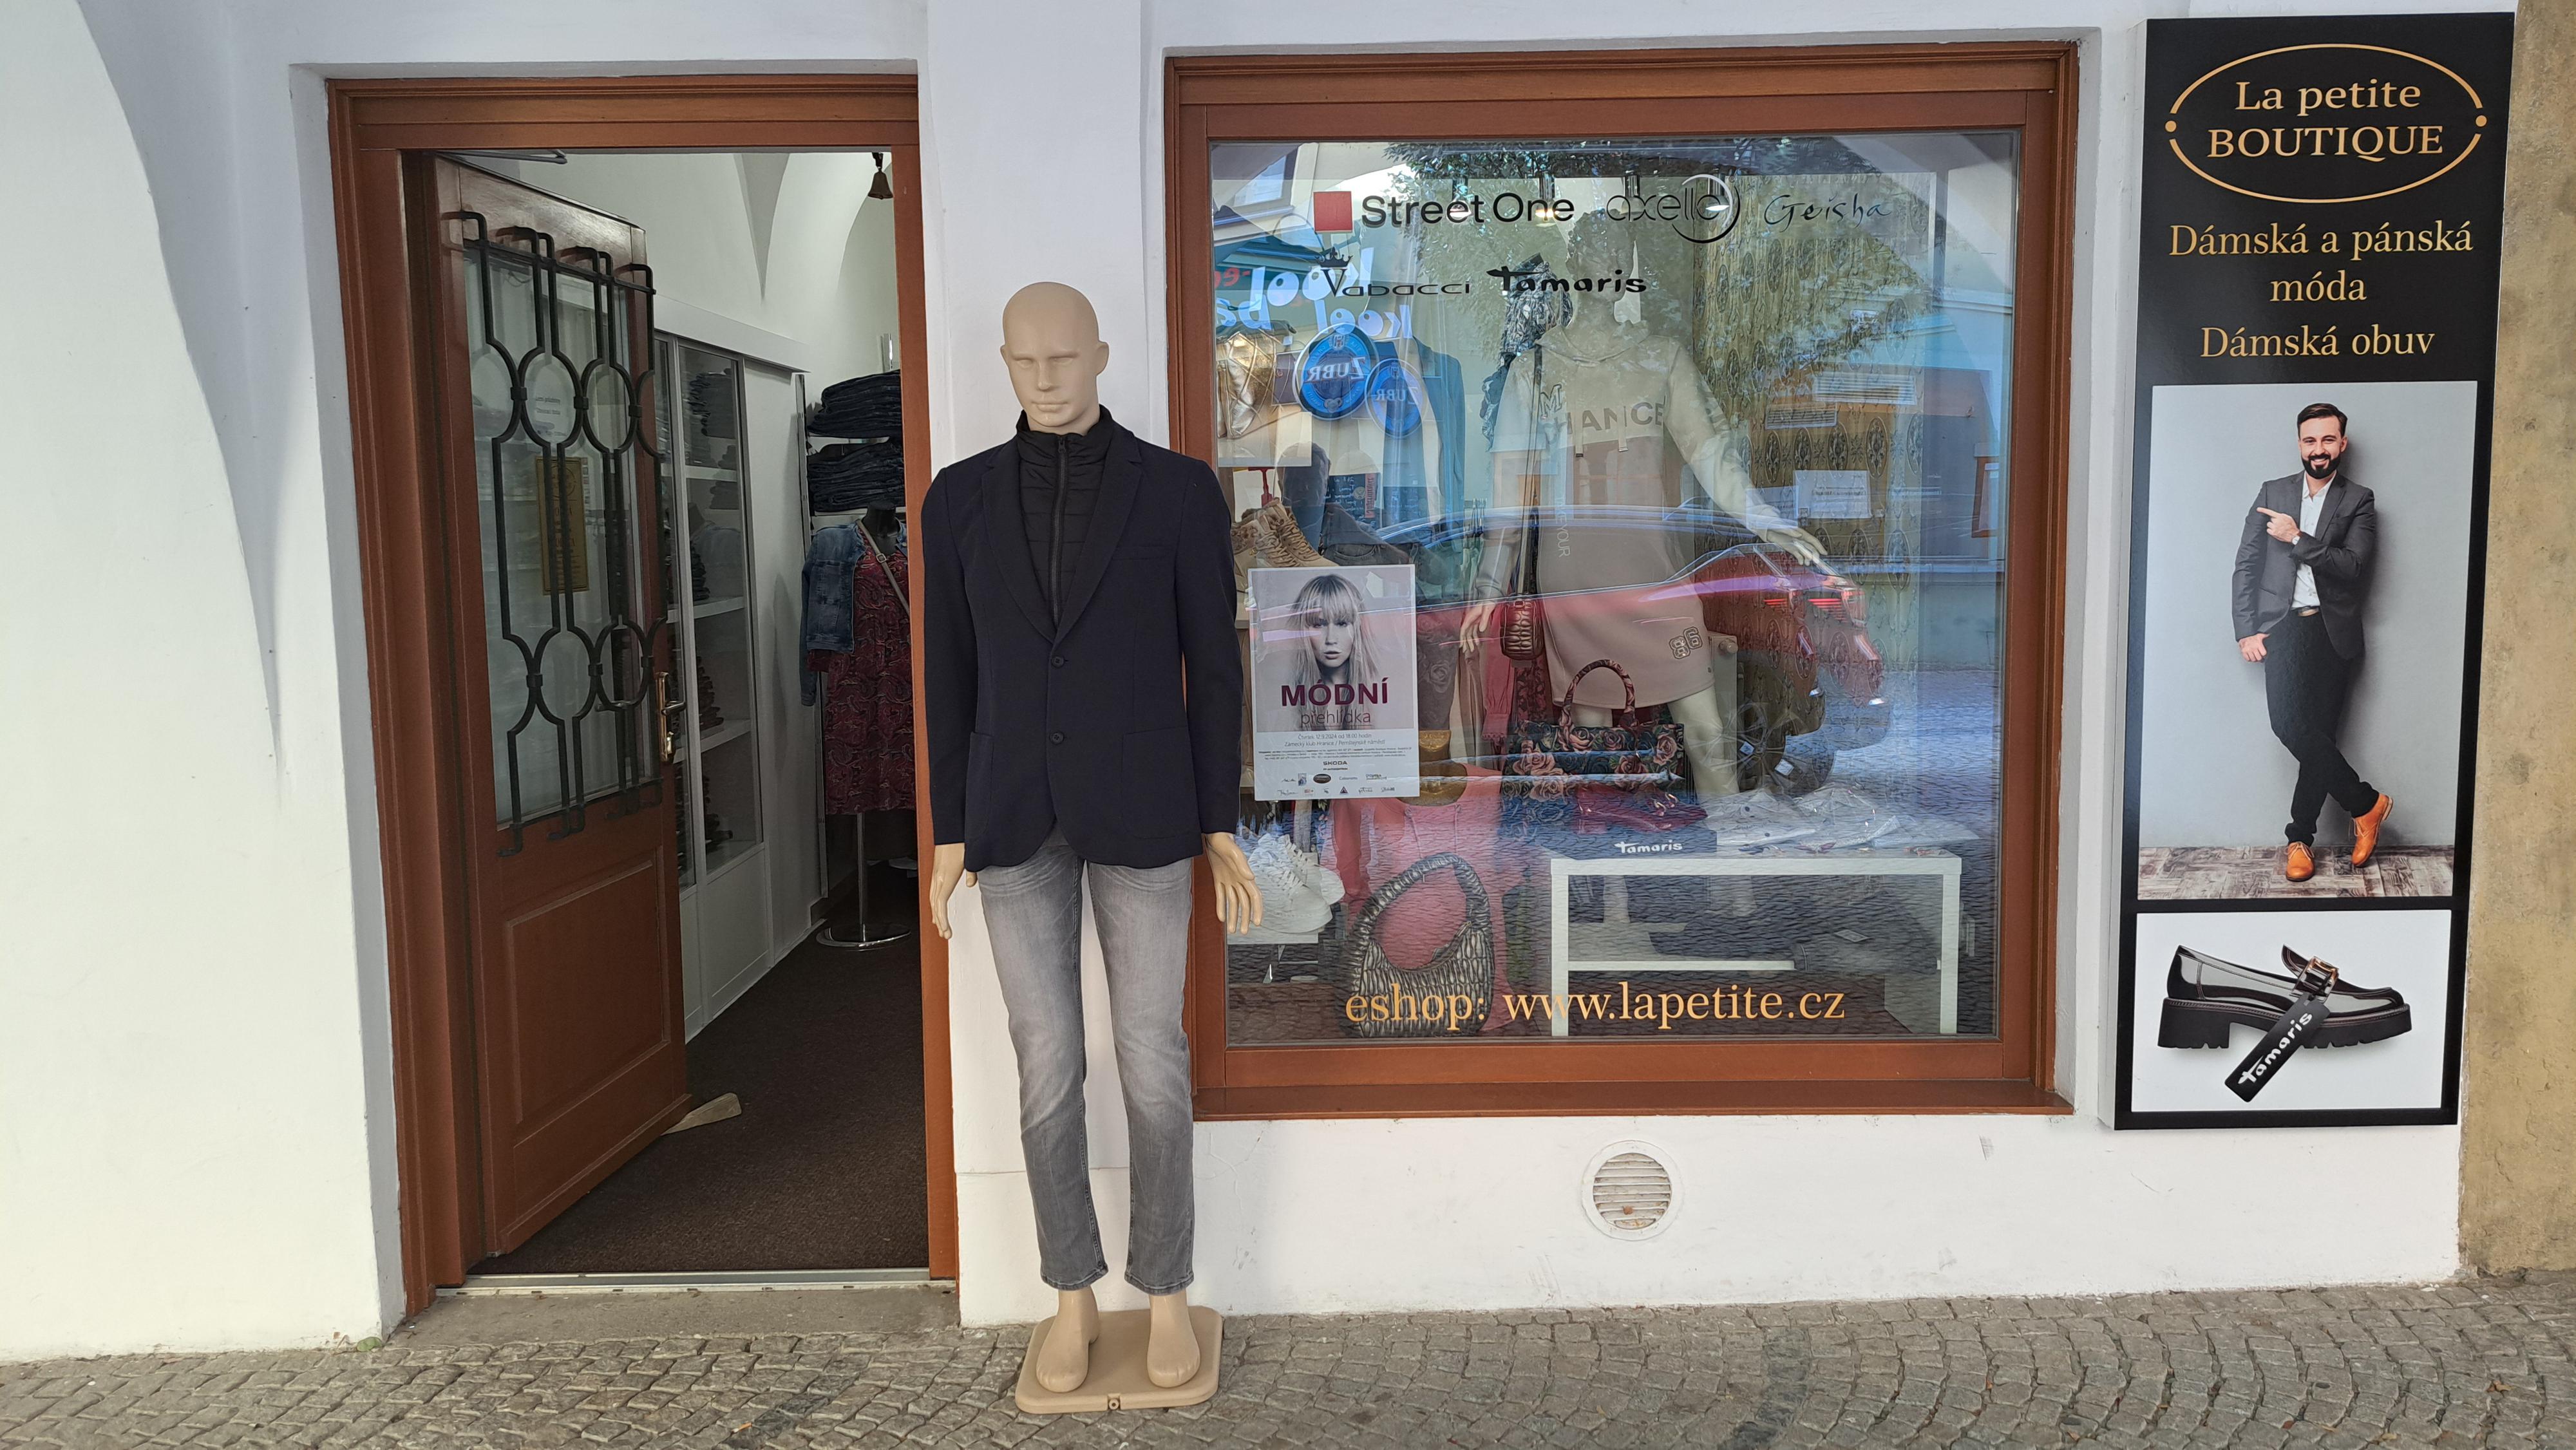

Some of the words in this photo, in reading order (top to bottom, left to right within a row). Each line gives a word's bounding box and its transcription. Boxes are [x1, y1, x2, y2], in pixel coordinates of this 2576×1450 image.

[2235, 81, 2284, 111] La
[2297, 78, 2421, 117] petite
[2207, 126, 2444, 162] BOUTIQUE
[1361, 194, 1484, 227] Street
[1493, 193, 1575, 222] One
[1764, 192, 1892, 232] Geisha
[2170, 222, 2309, 256] Dámská
[2322, 229, 2340, 253] a
[2351, 220, 2474, 261] pánská
[1320, 268, 1470, 297] Vabacci
[1486, 265, 1647, 293] Tamaris
[2270, 270, 2367, 302] móda
[2200, 324, 2340, 358] Dámská
[2352, 323, 2435, 355] obuv
[1556, 523, 1571, 558] YOUR
[1281, 678, 1388, 706] MÓDNÍ
[1300, 709, 1371, 726] přehlídka
[1614, 840, 1683, 854] Tamaris
[1345, 983, 1486, 1030] eshop:
[1502, 981, 1846, 1030] www.lapetite.cz
[2237, 1012, 2313, 1085] Tamaris
